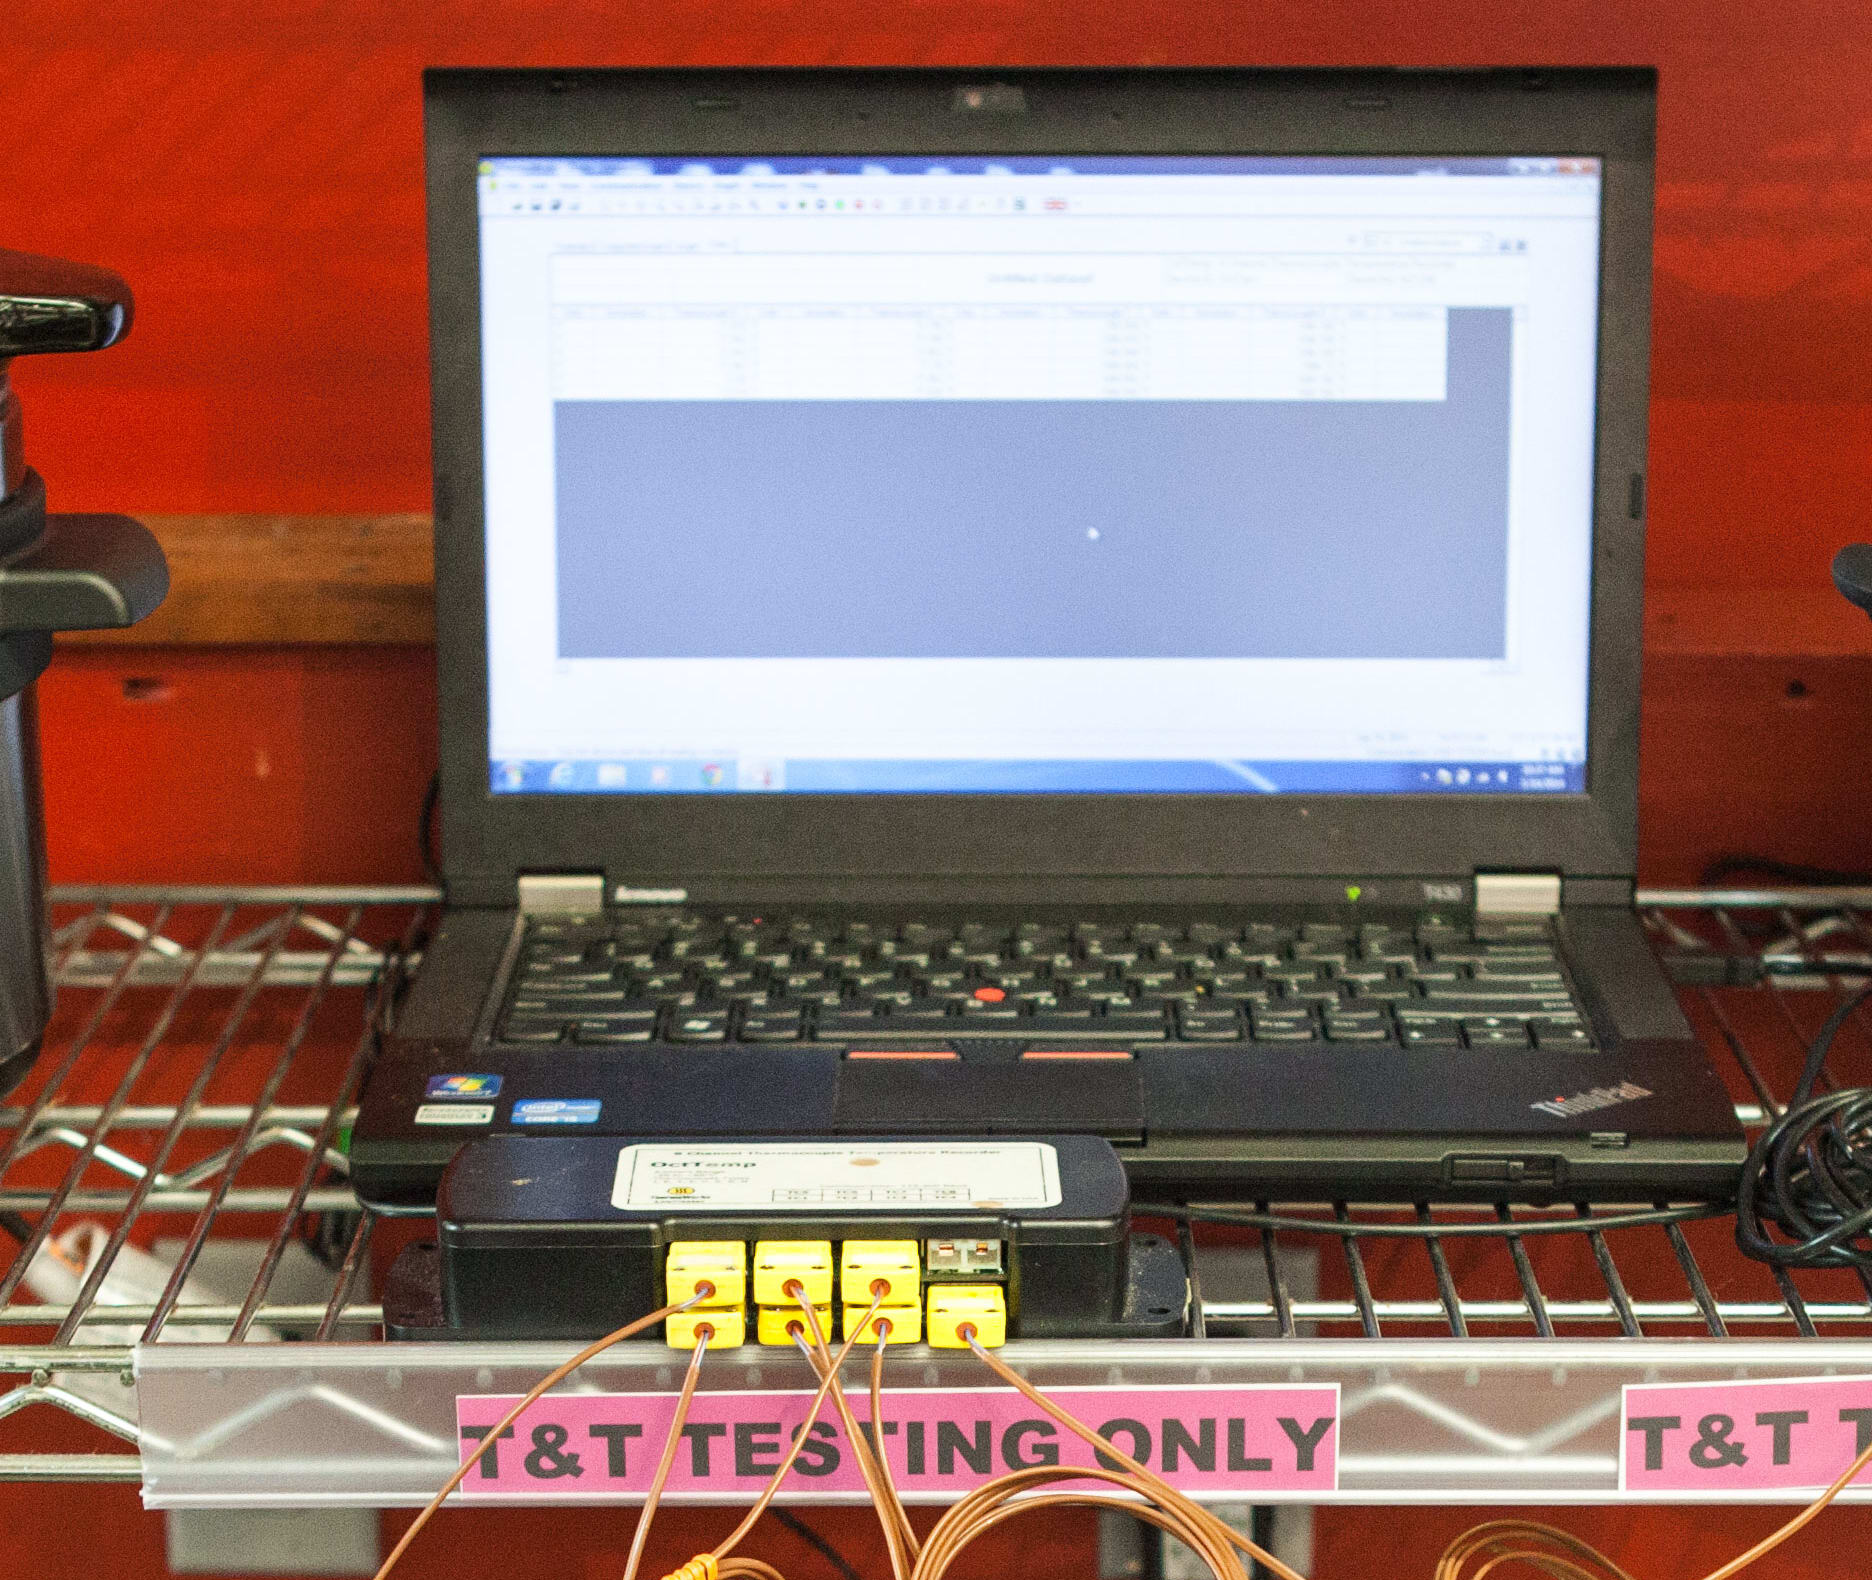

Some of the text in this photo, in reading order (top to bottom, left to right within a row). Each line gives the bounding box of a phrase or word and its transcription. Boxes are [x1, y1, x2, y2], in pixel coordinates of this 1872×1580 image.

[461, 1422, 643, 1480] T&T
[1093, 1414, 1336, 1474] ONLY
[1628, 1410, 1809, 1472] T&T
